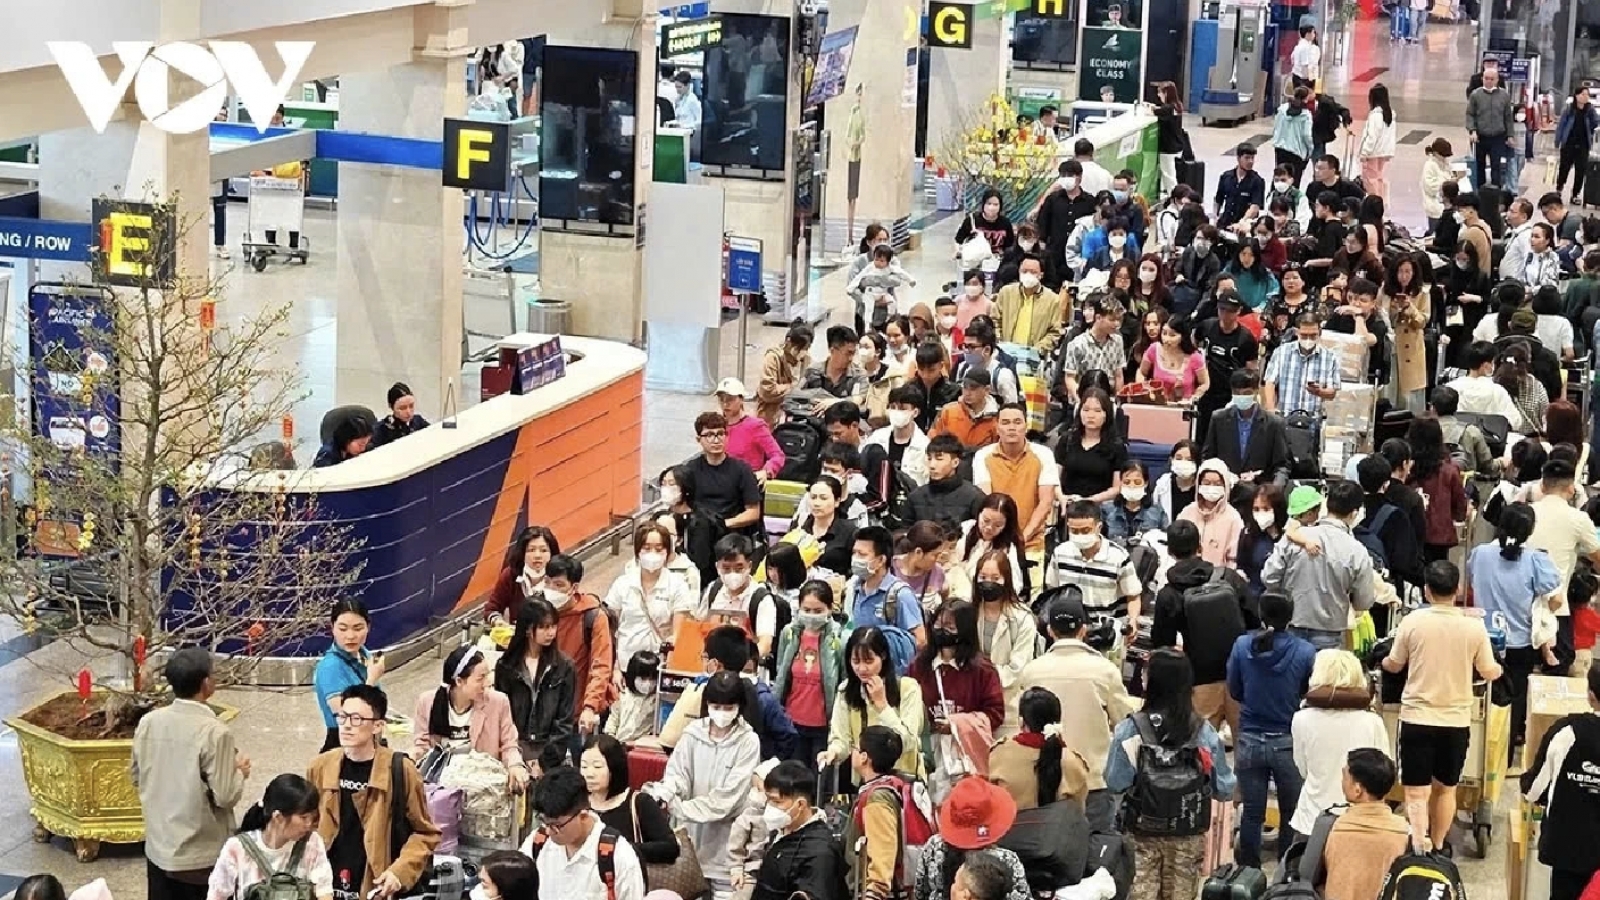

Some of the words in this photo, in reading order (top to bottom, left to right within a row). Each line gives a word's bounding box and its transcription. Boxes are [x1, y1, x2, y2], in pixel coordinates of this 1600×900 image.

[935, 6, 965, 44] G
[1089, 58, 1131, 69] ECONOMY
[1096, 69, 1124, 79] CLASS
[457, 129, 493, 179] F
[34, 235, 72, 252] ROW
[108, 212, 153, 276] E
